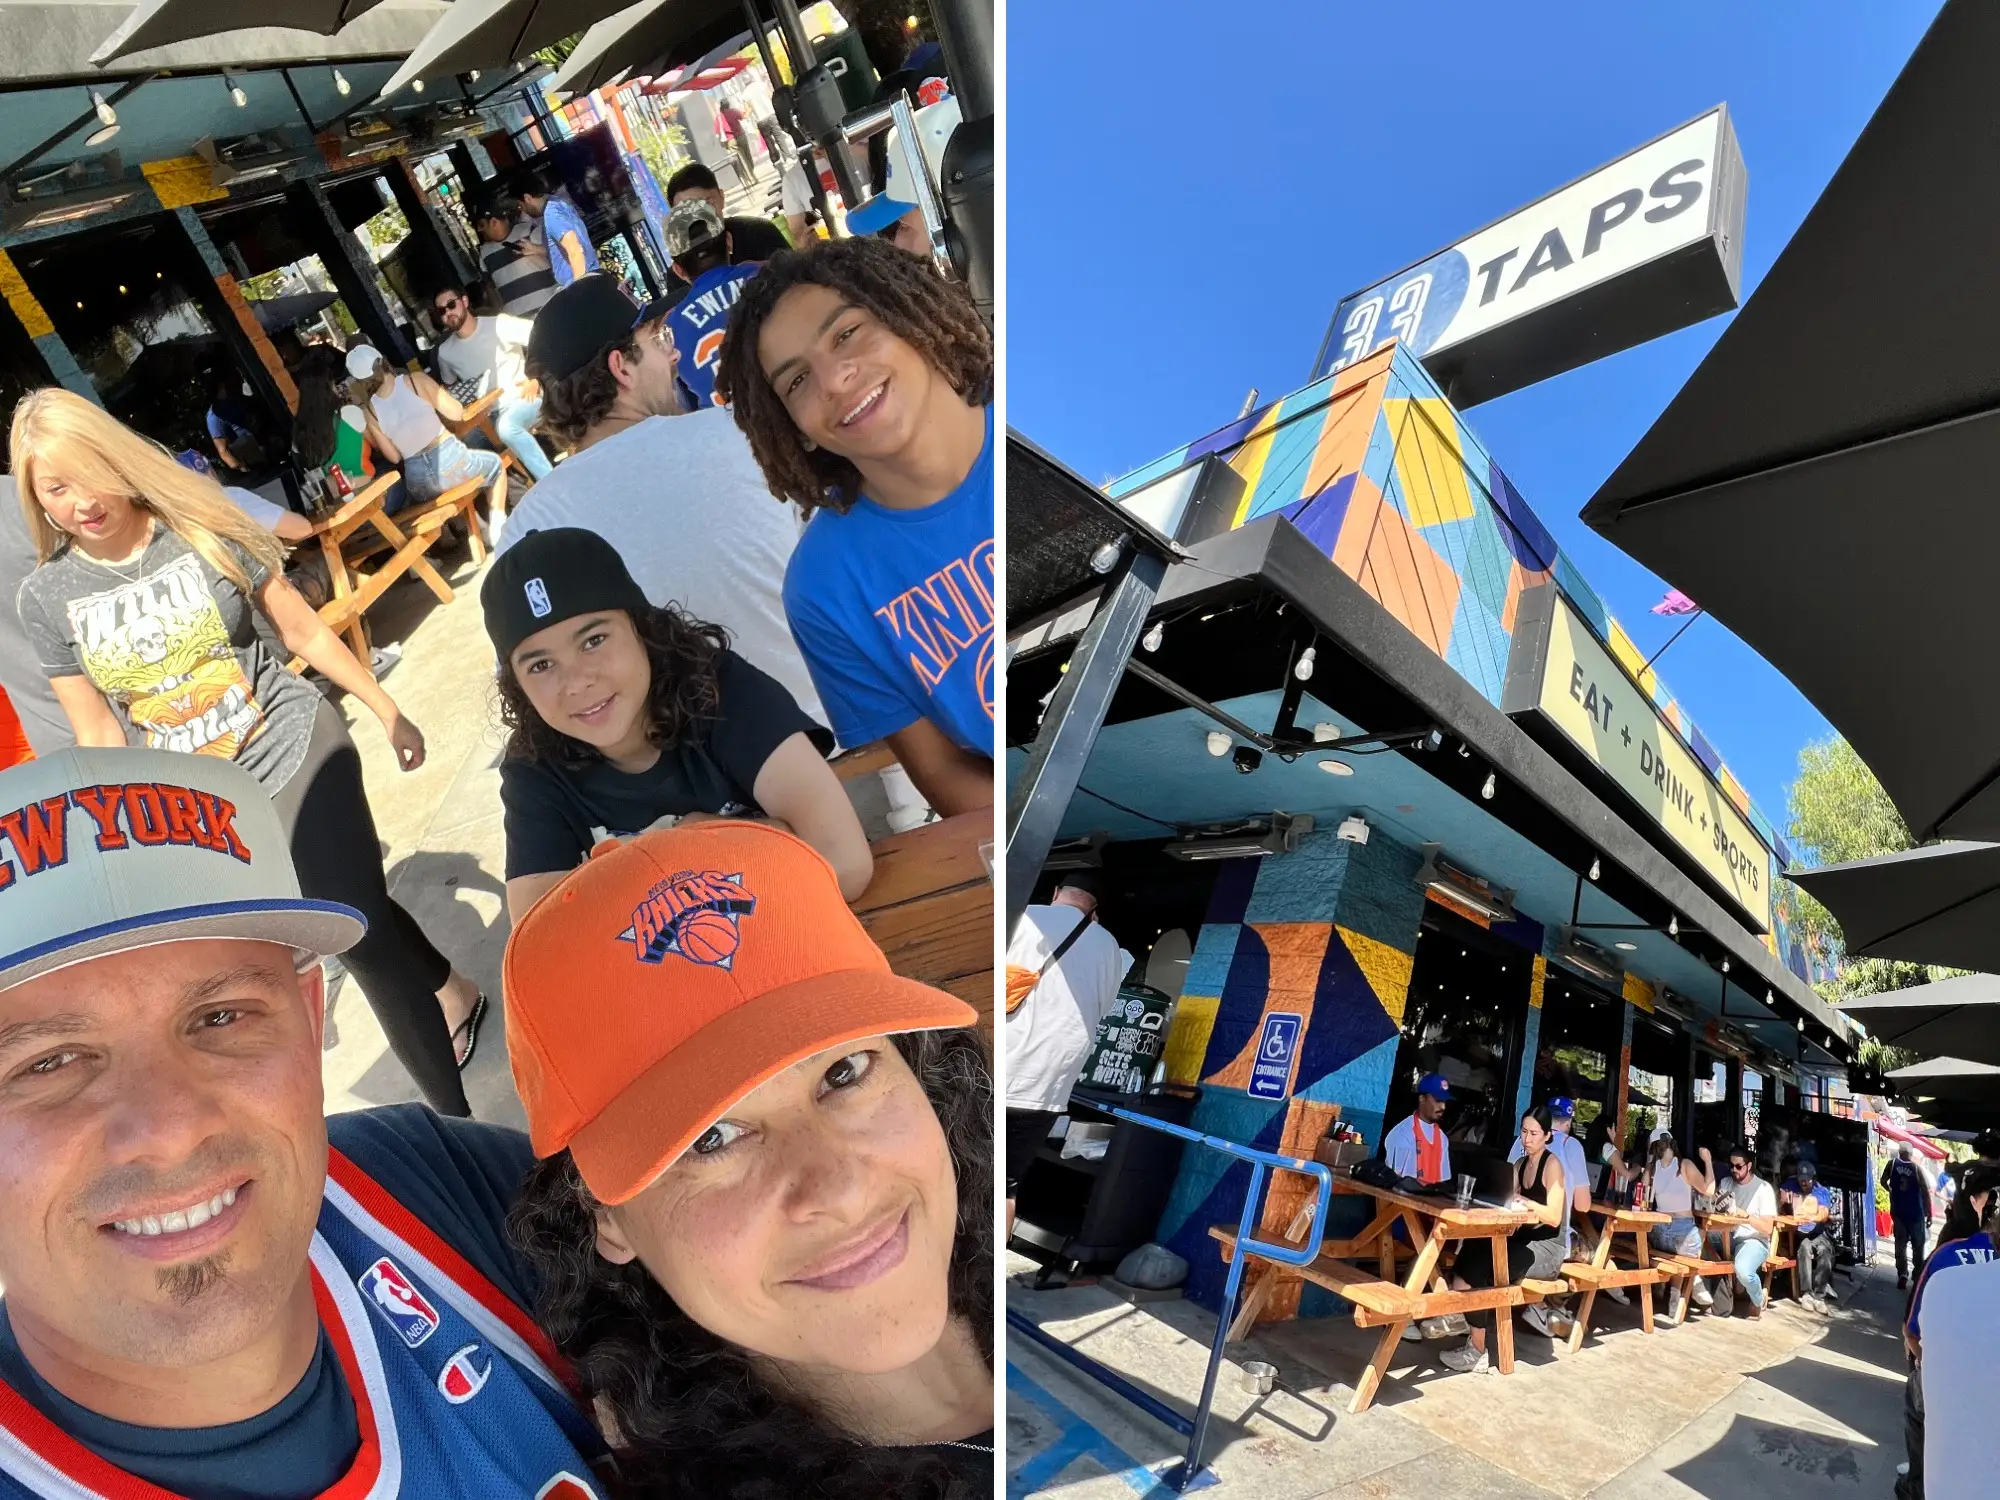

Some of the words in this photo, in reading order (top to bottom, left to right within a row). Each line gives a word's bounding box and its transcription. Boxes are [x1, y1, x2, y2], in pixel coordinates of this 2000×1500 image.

[1478, 158, 1705, 307] TAPS
[681, 277, 745, 329] EWIN
[1569, 661, 1613, 733] EAT
[1639, 739, 1695, 824] DRINK
[1713, 823, 1759, 892] SPORTS
[69, 783, 251, 865] YORK
[632, 871, 756, 964] KNICKS
[1098, 1049, 1132, 1070] GETS
[1255, 1064, 1287, 1078] ENTRANCE
[1955, 1248, 1995, 1265] EWI
[405, 1317, 429, 1341] NBA
